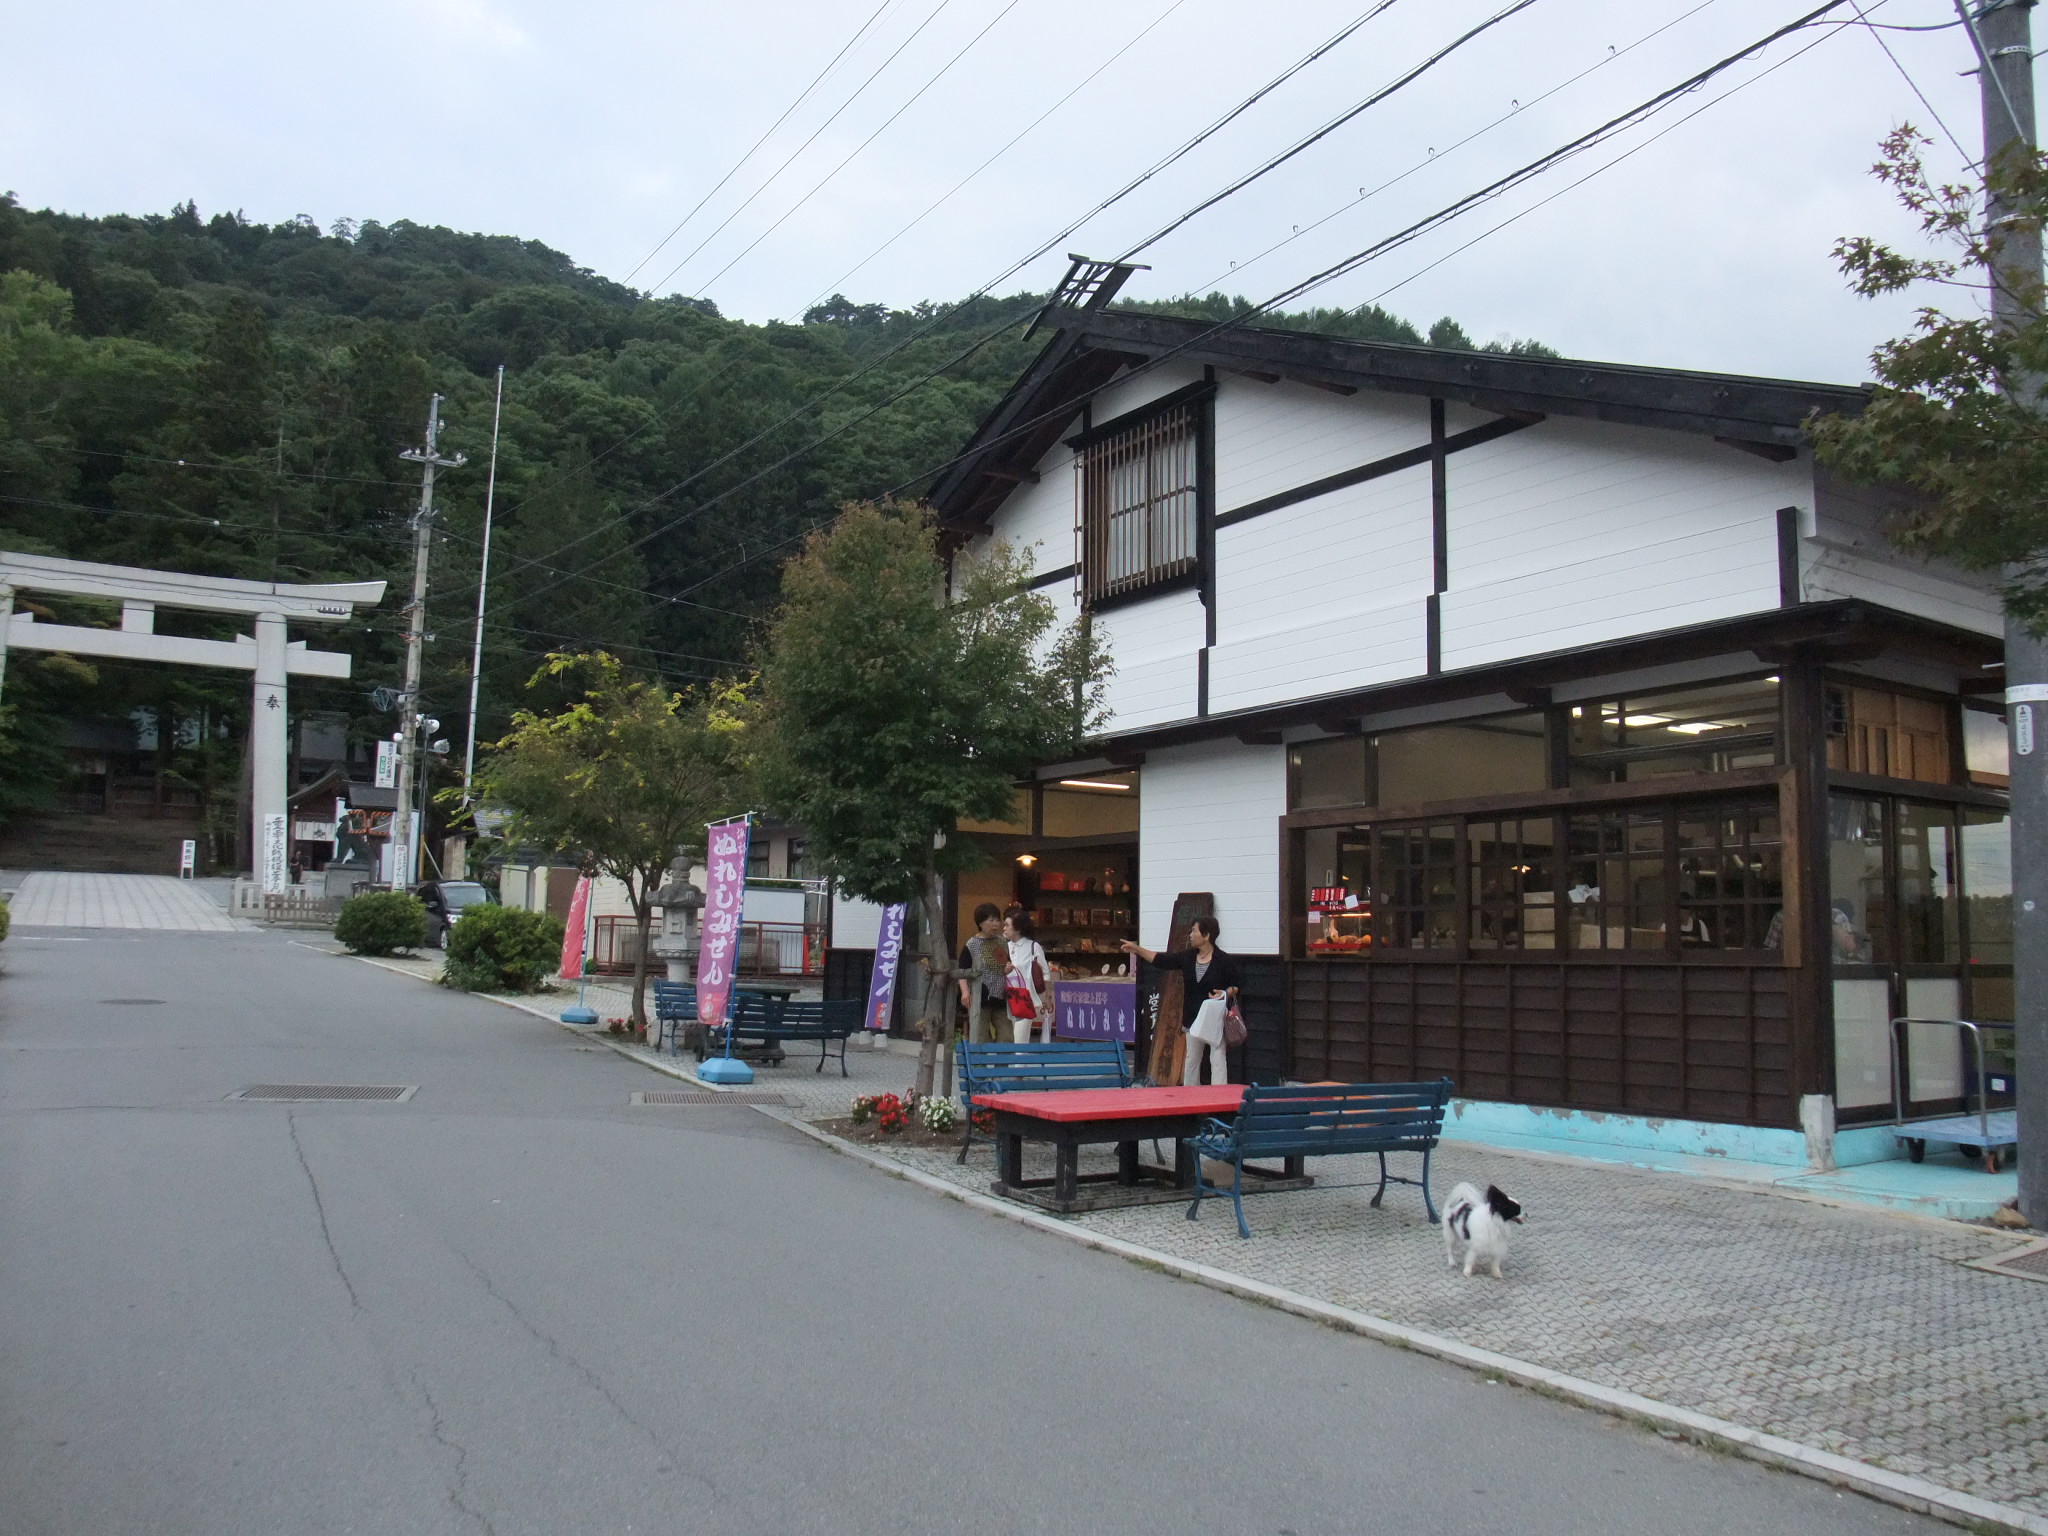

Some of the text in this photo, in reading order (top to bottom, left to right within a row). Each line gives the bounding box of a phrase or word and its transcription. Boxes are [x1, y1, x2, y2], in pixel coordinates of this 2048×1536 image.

[265, 694, 280, 711] 奉
[702, 833, 738, 985] ぬれしみせん
[1066, 1006, 1136, 1032] ぬれしみせ
